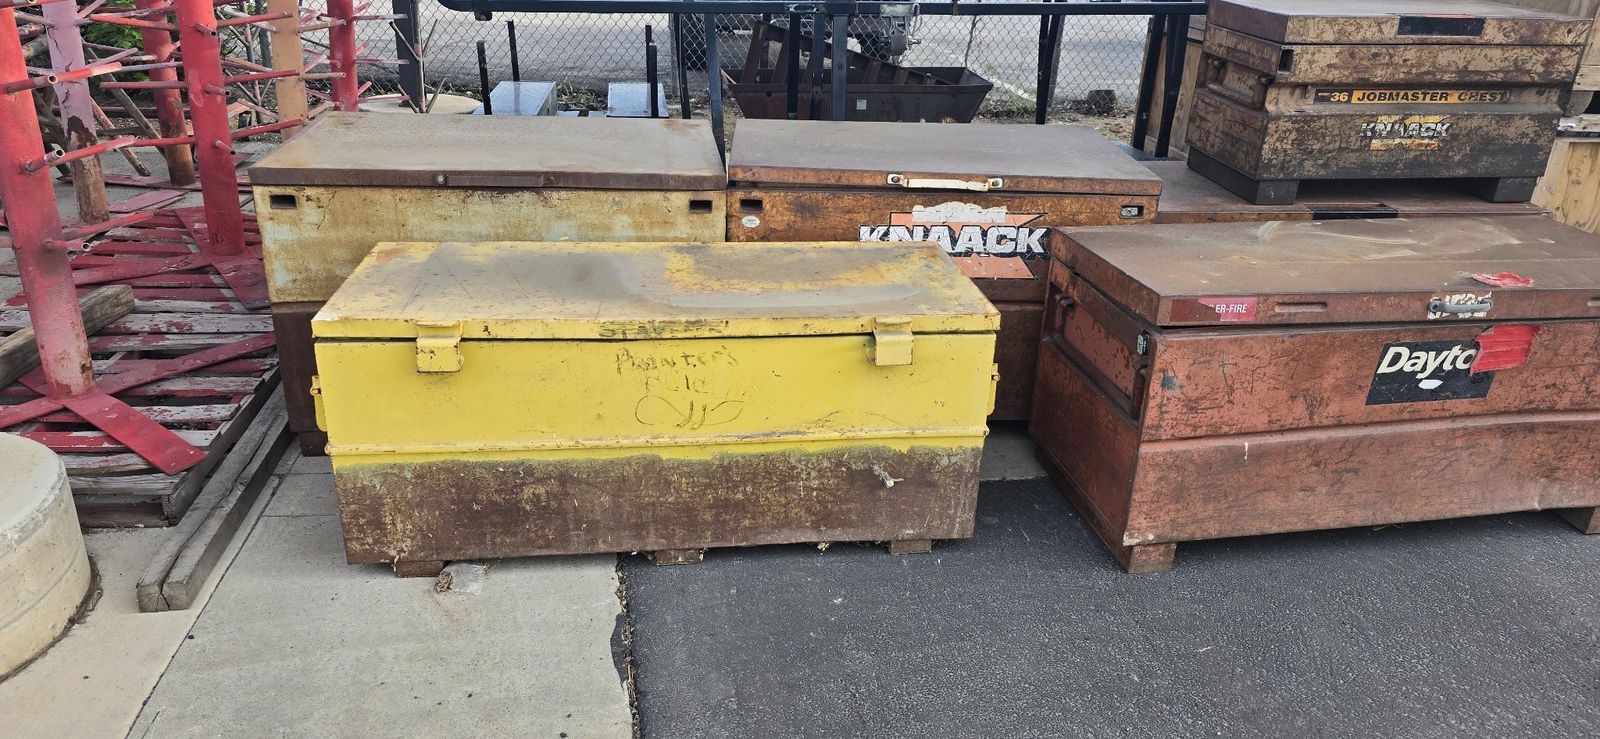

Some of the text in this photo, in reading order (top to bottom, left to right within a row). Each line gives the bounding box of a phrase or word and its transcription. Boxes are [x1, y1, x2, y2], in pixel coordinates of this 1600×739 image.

[1330, 92, 1349, 102] 36
[1357, 91, 1449, 102] JOBMASTER
[1457, 91, 1508, 102] CHEST
[859, 224, 1047, 256] KNAACK
